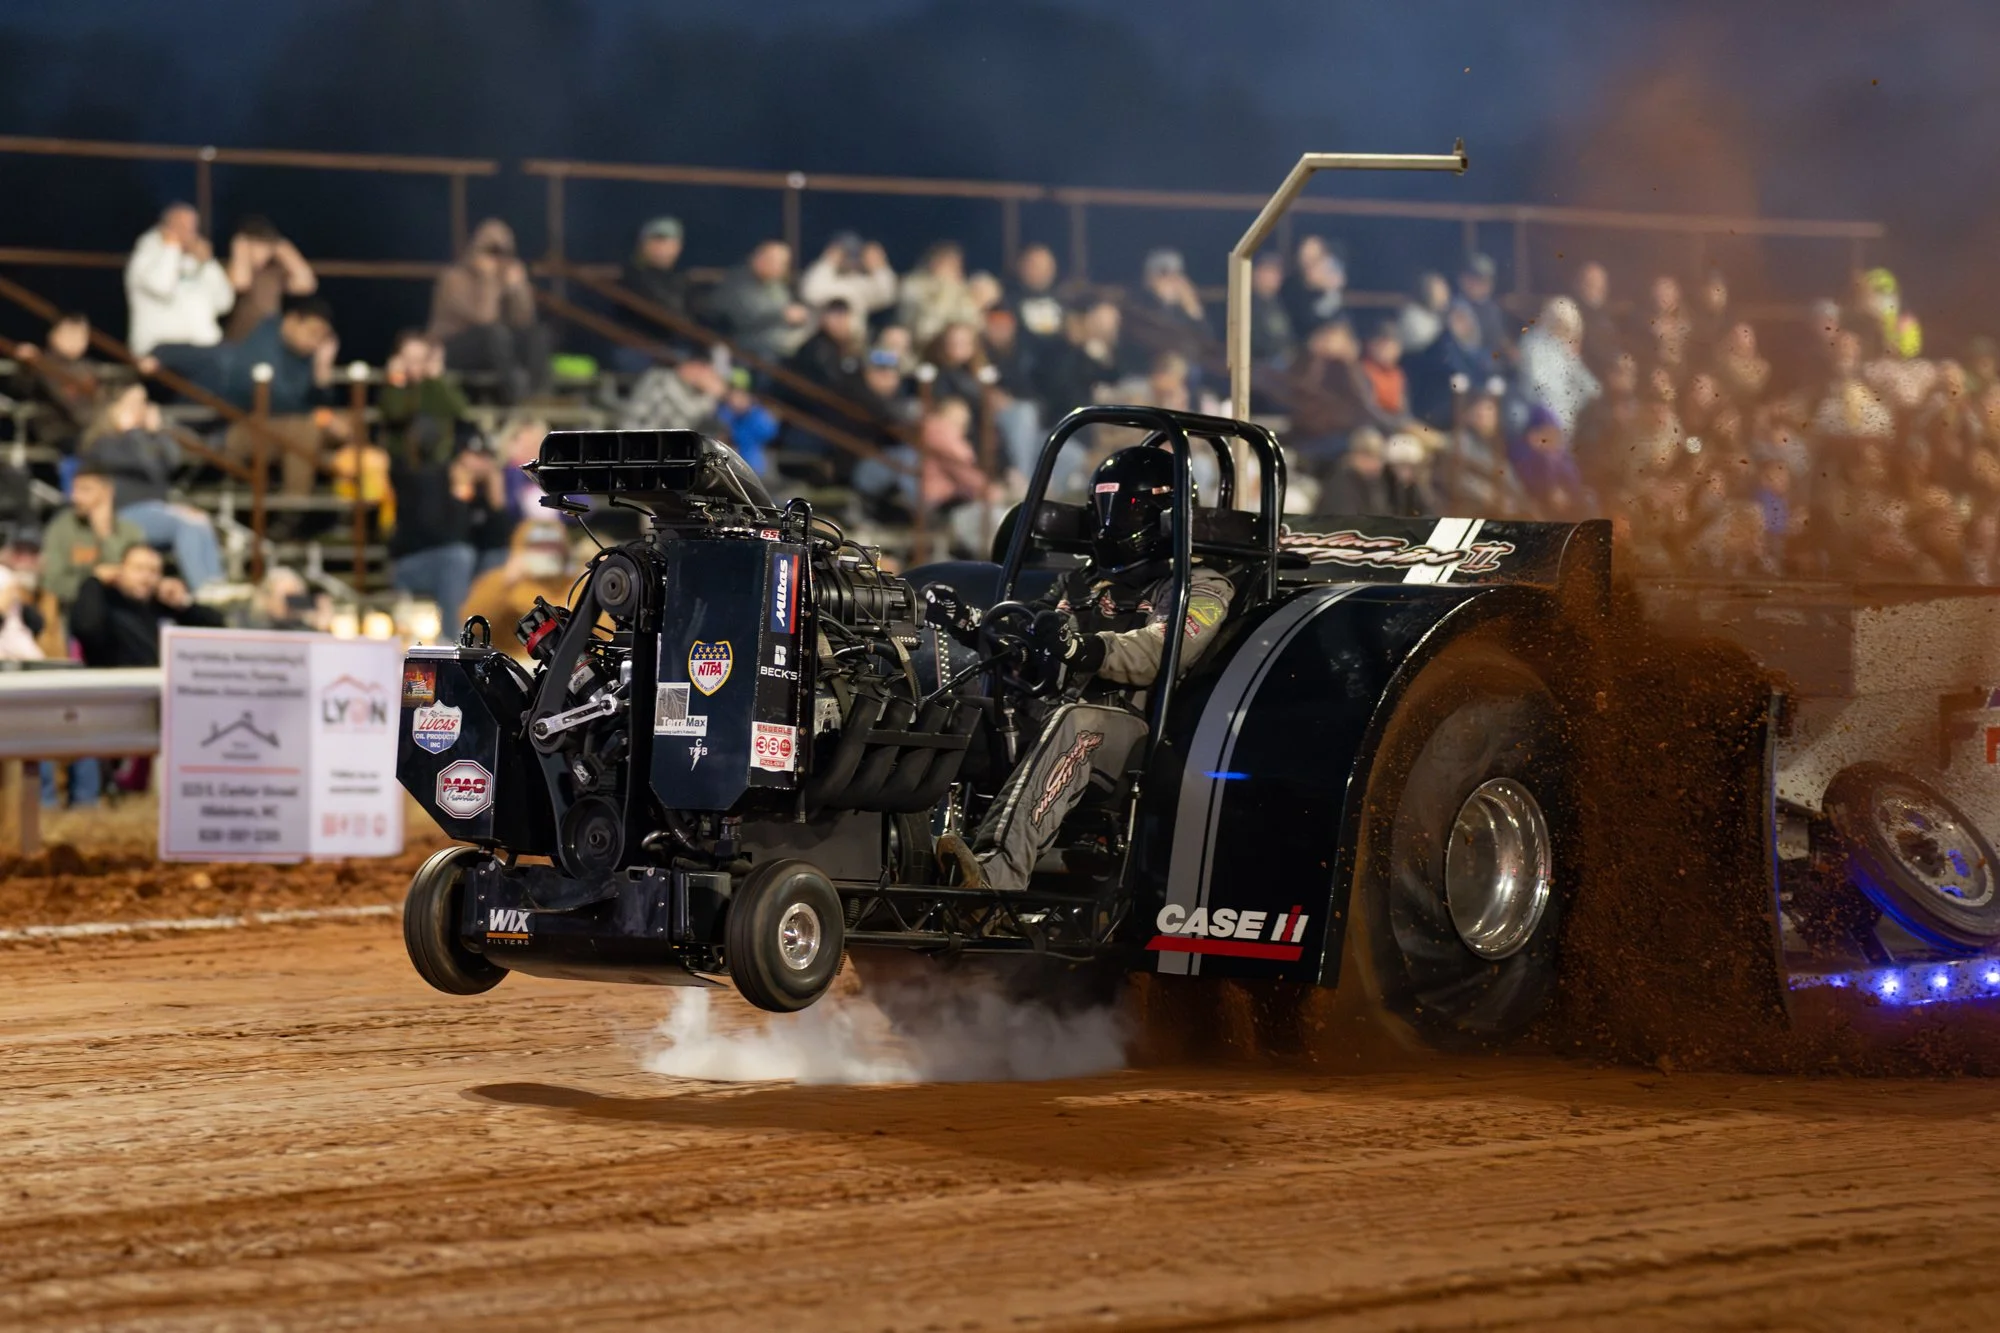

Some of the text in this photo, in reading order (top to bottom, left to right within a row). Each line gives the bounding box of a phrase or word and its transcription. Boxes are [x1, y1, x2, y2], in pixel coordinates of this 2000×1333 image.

[698, 661, 722, 676] NTPA
[760, 666, 798, 681] BECK'S
[419, 718, 459, 731] LUCAS
[489, 908, 531, 933] WIX
[1156, 903, 1268, 940] CASE
